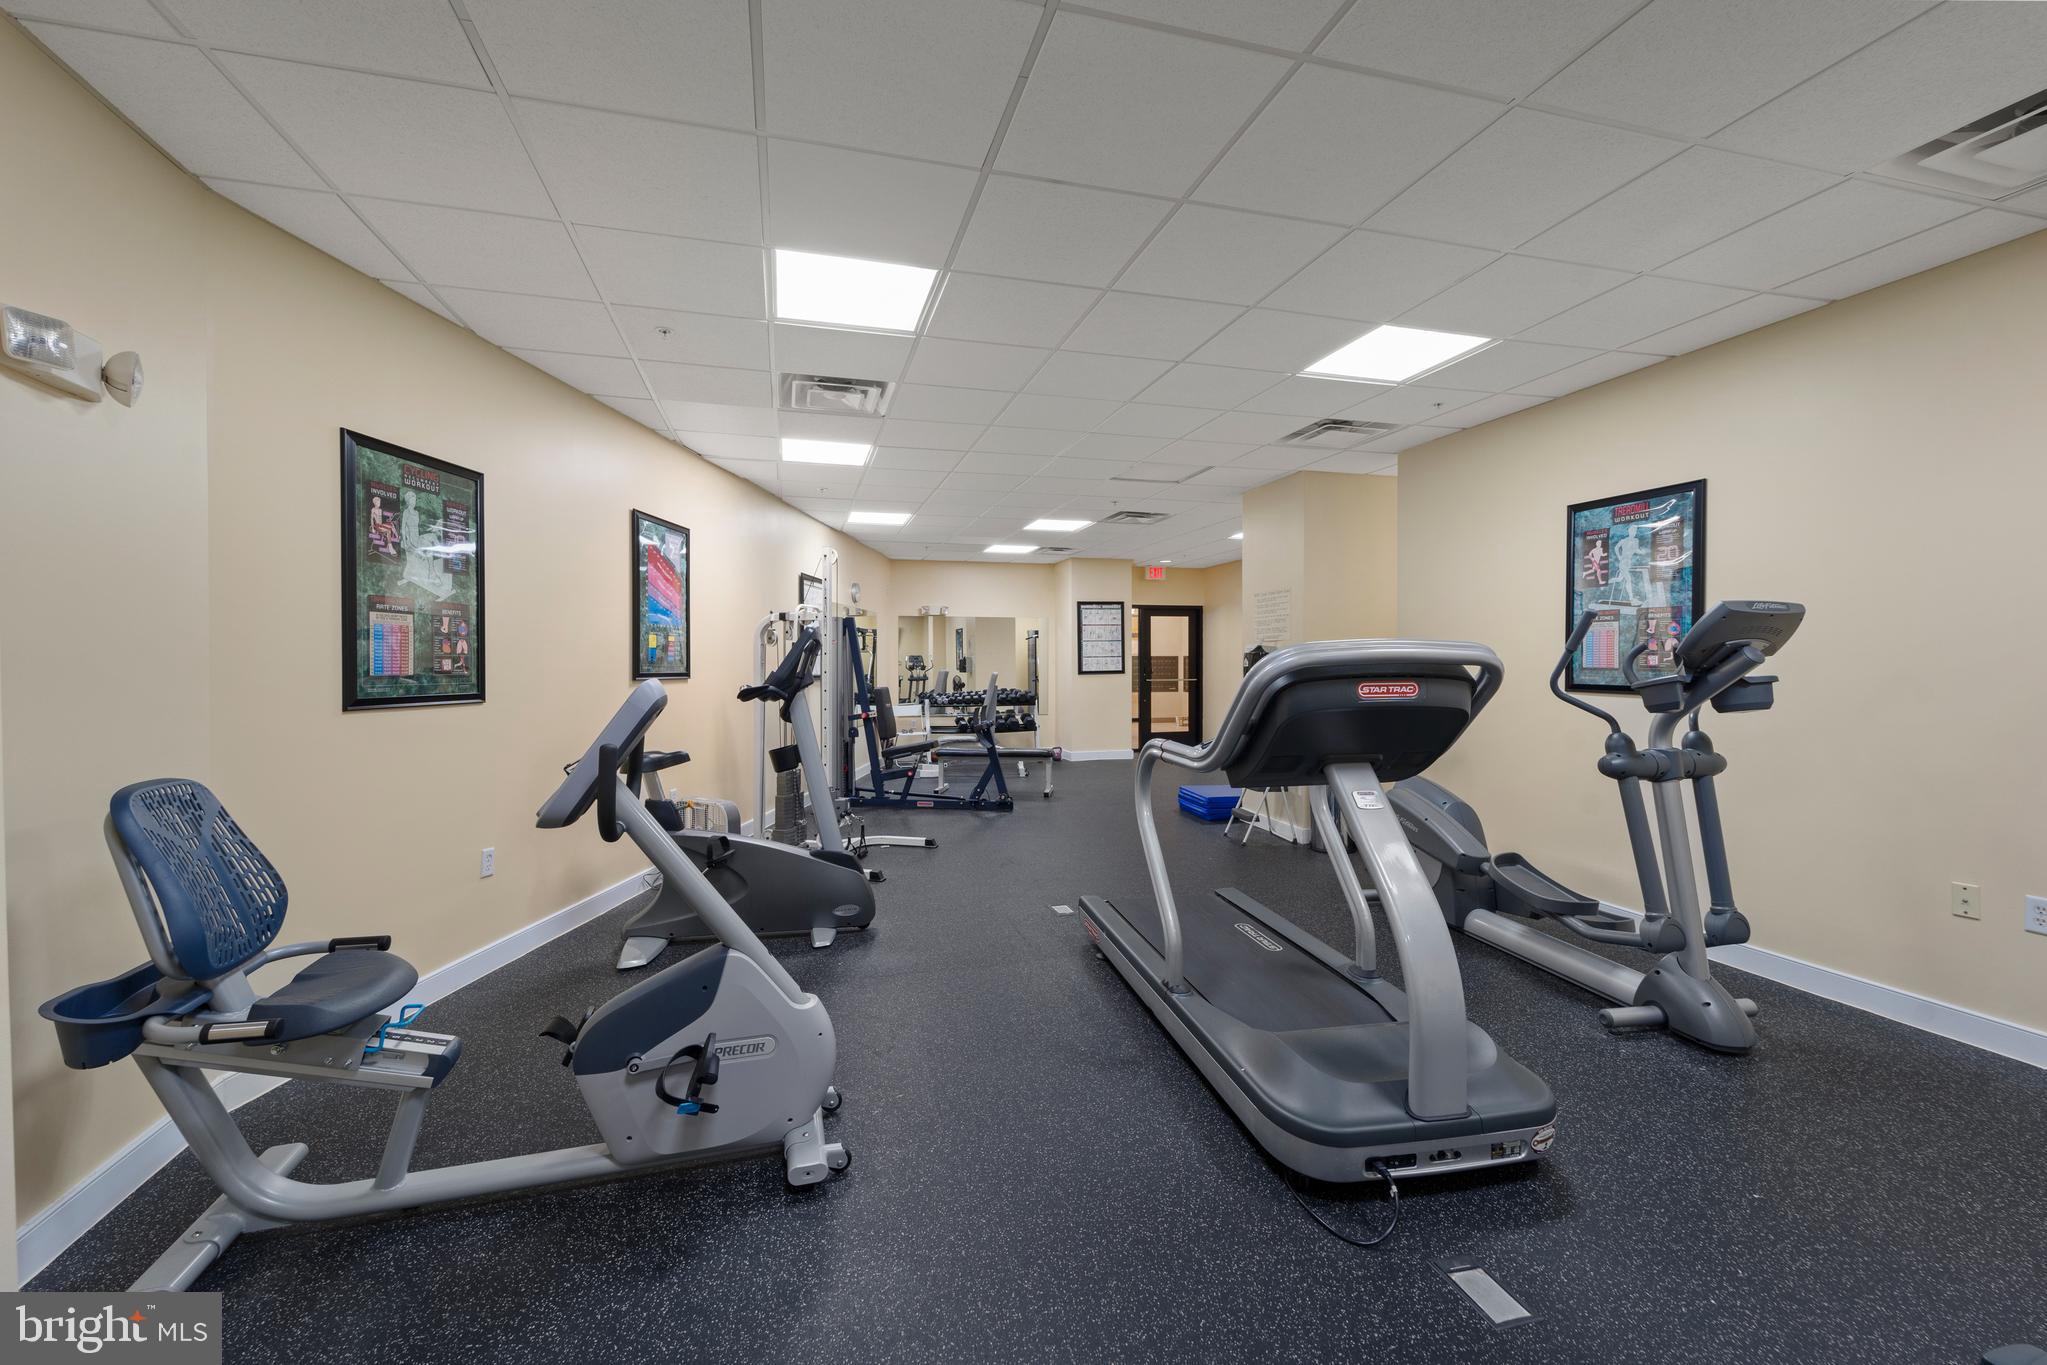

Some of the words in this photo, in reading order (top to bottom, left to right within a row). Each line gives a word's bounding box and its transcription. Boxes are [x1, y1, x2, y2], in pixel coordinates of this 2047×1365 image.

[404, 478, 439, 492] WORKOUT
[370, 487, 397, 499] INVOLVED
[1614, 512, 1649, 523] WORKOUT
[1149, 567, 1163, 578] EXIT
[714, 1042, 765, 1057] PRECOR
